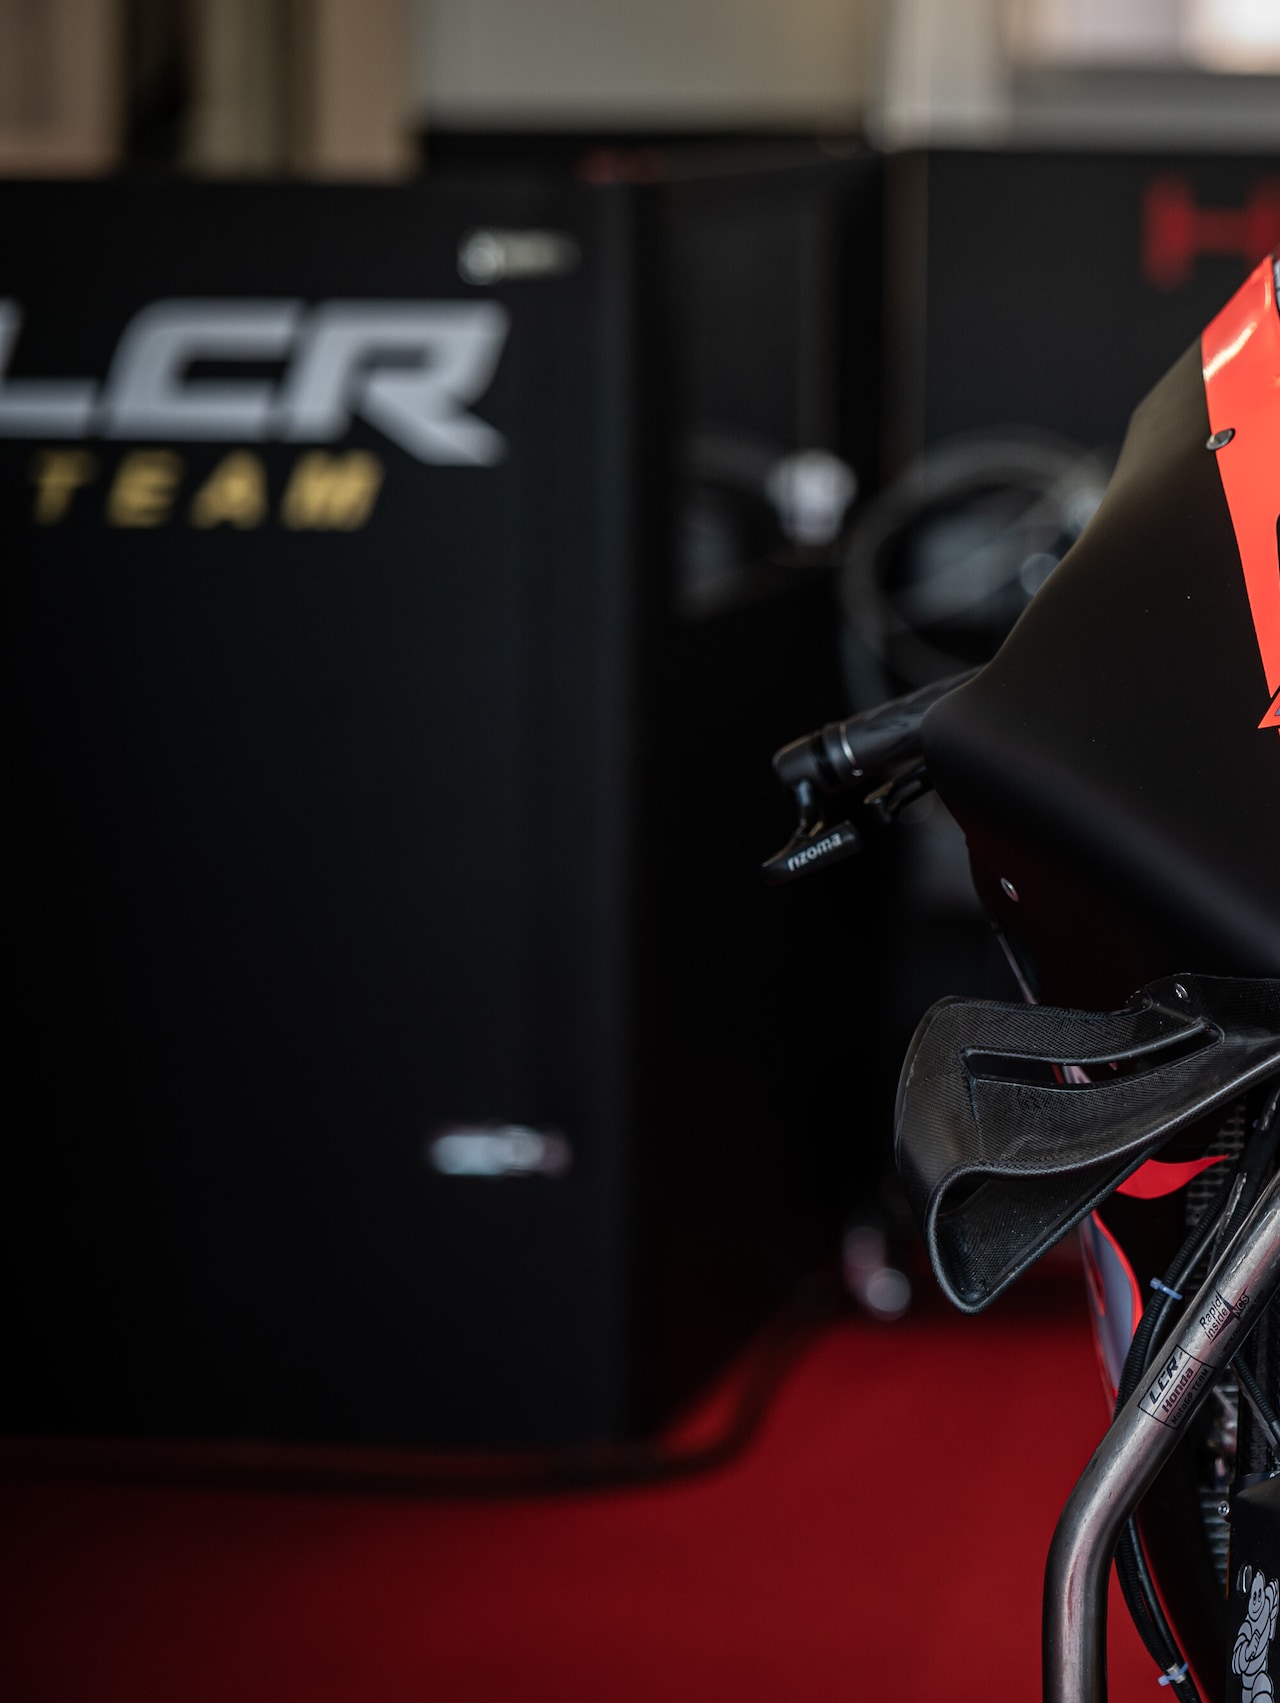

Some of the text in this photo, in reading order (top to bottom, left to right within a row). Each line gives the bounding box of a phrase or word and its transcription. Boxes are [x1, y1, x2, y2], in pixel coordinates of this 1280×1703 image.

[0, 298, 508, 466] LCR
[33, 450, 384, 531] TEAM
[787, 833, 842, 872] rizoma
[1199, 1296, 1223, 1330] Rapid
[1206, 1308, 1229, 1341] Inside
[1233, 1294, 1250, 1316] NCS
[1149, 1355, 1179, 1405] LCR
[1162, 1367, 1195, 1413] Honda
[1171, 1393, 1194, 1425] MotoGP
